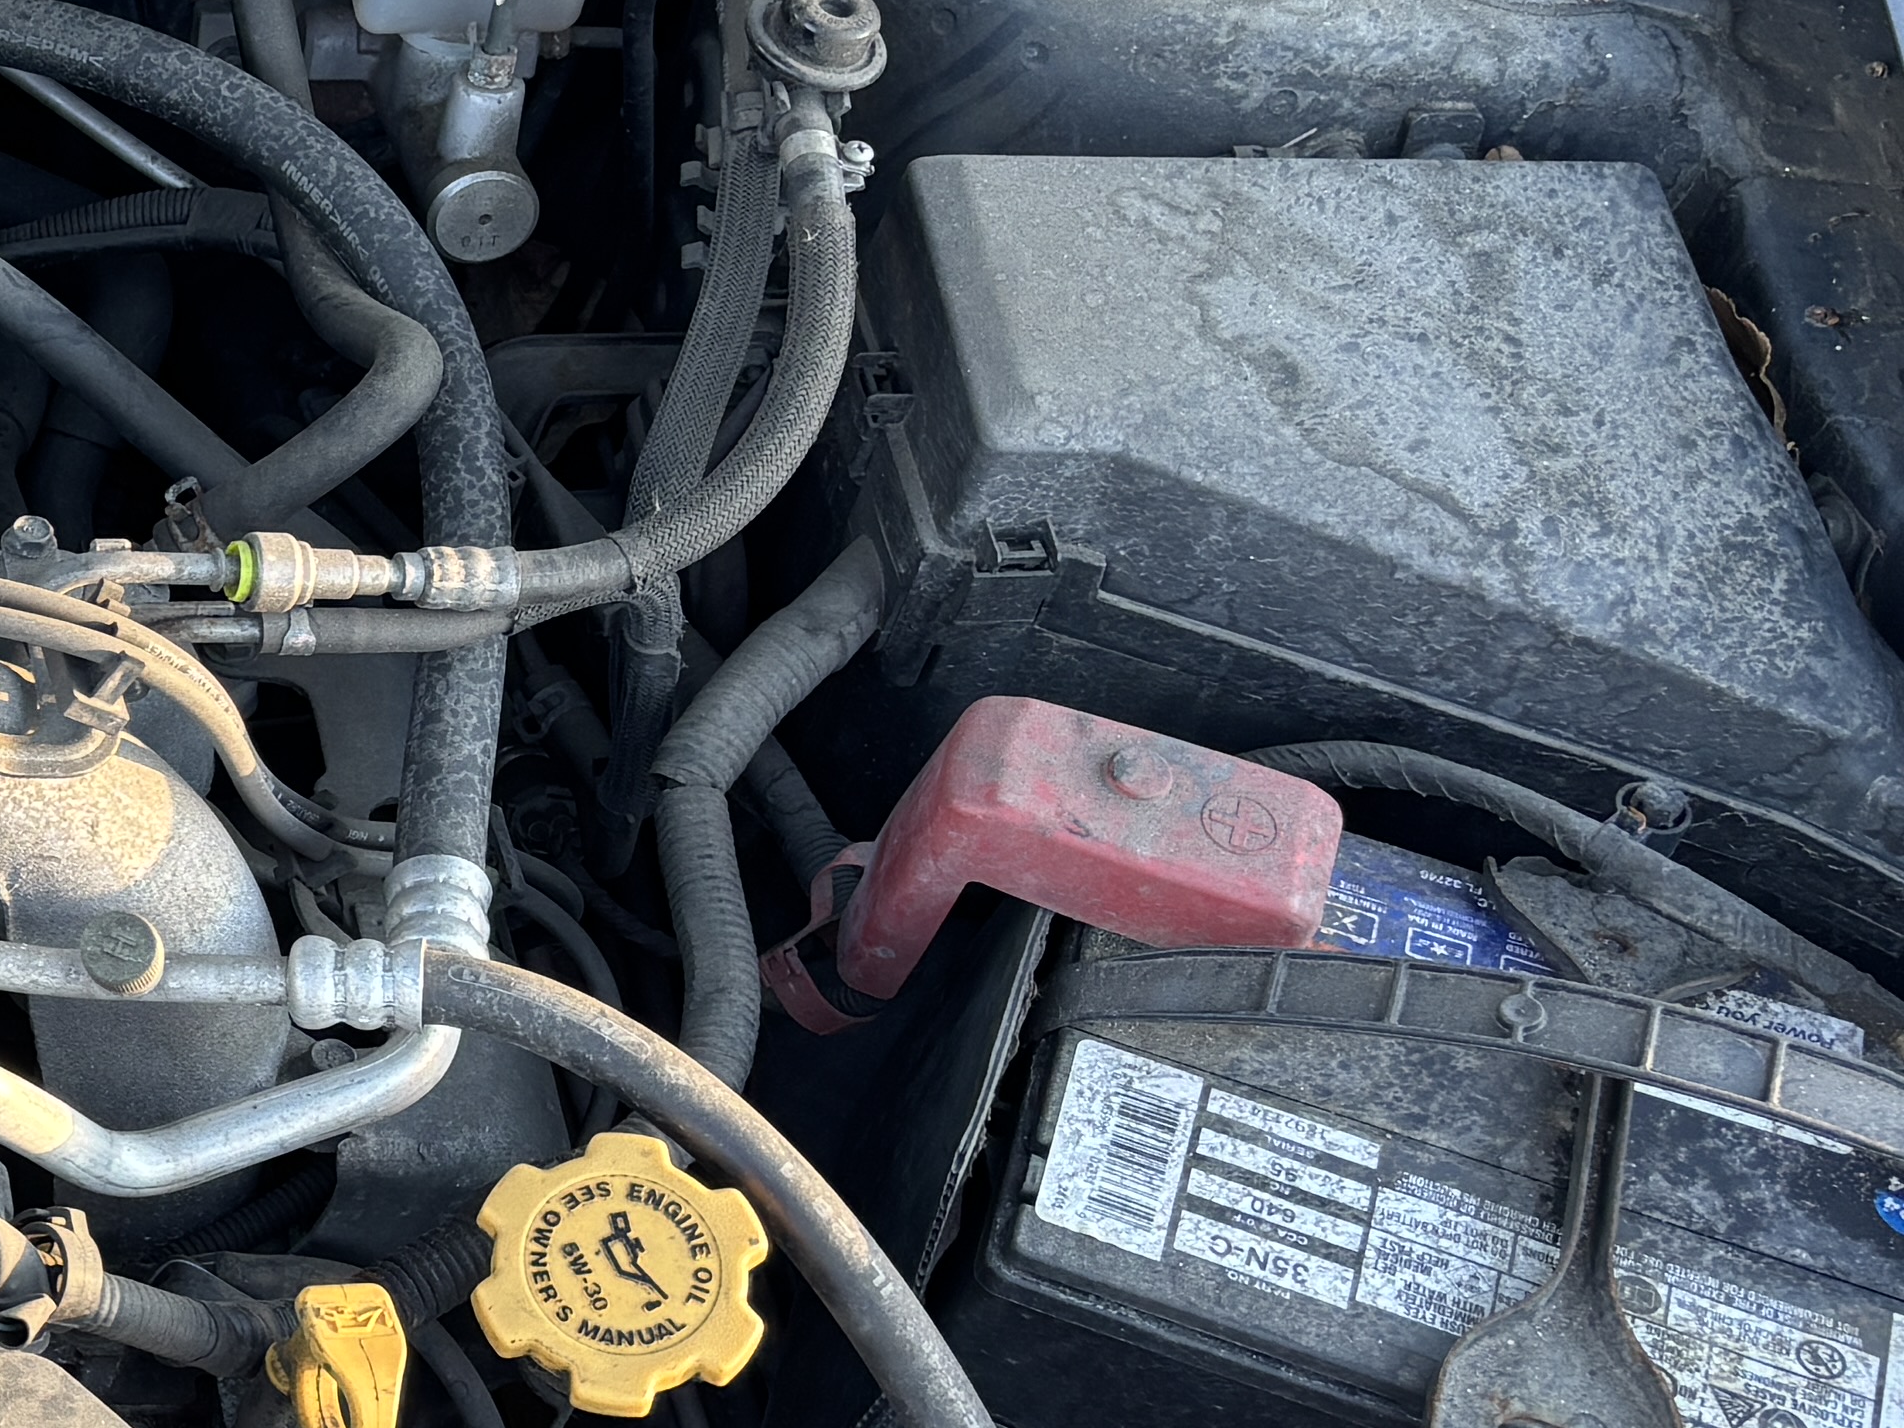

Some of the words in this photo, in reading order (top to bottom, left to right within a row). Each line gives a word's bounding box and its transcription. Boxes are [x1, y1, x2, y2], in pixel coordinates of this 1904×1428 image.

[278, 154, 372, 266] INNER>IIR<
[1715, 1002, 1761, 1028] you
[1764, 1017, 1835, 1050] Power
[1262, 1133, 1316, 1159] SERIAL
[1266, 1159, 1300, 1184] 95
[562, 1181, 612, 1211] SEE
[1247, 1195, 1297, 1225] 640
[627, 1182, 712, 1262] ENGINE
[685, 1267, 713, 1313] OIL
[1274, 1227, 1309, 1246] CCA
[1464, 1236, 1488, 1253] NOT
[528, 1209, 574, 1323] OWNER'S
[1205, 1231, 1311, 1287] 35N-C
[1414, 1249, 1450, 1270] HELP
[1222, 1267, 1250, 1286] NO.
[1253, 1278, 1292, 1300] PART
[1722, 1281, 1745, 1297] FOR
[1445, 1294, 1486, 1317] WITH
[577, 1317, 687, 1346] MANUAL
[1835, 1320, 1860, 1336] NOT
[1741, 1381, 1787, 1405] GASES
[1798, 1387, 1839, 1410] CAUSE
[1846, 1394, 1866, 1409] OR
[1839, 1402, 1866, 1419] CAN
